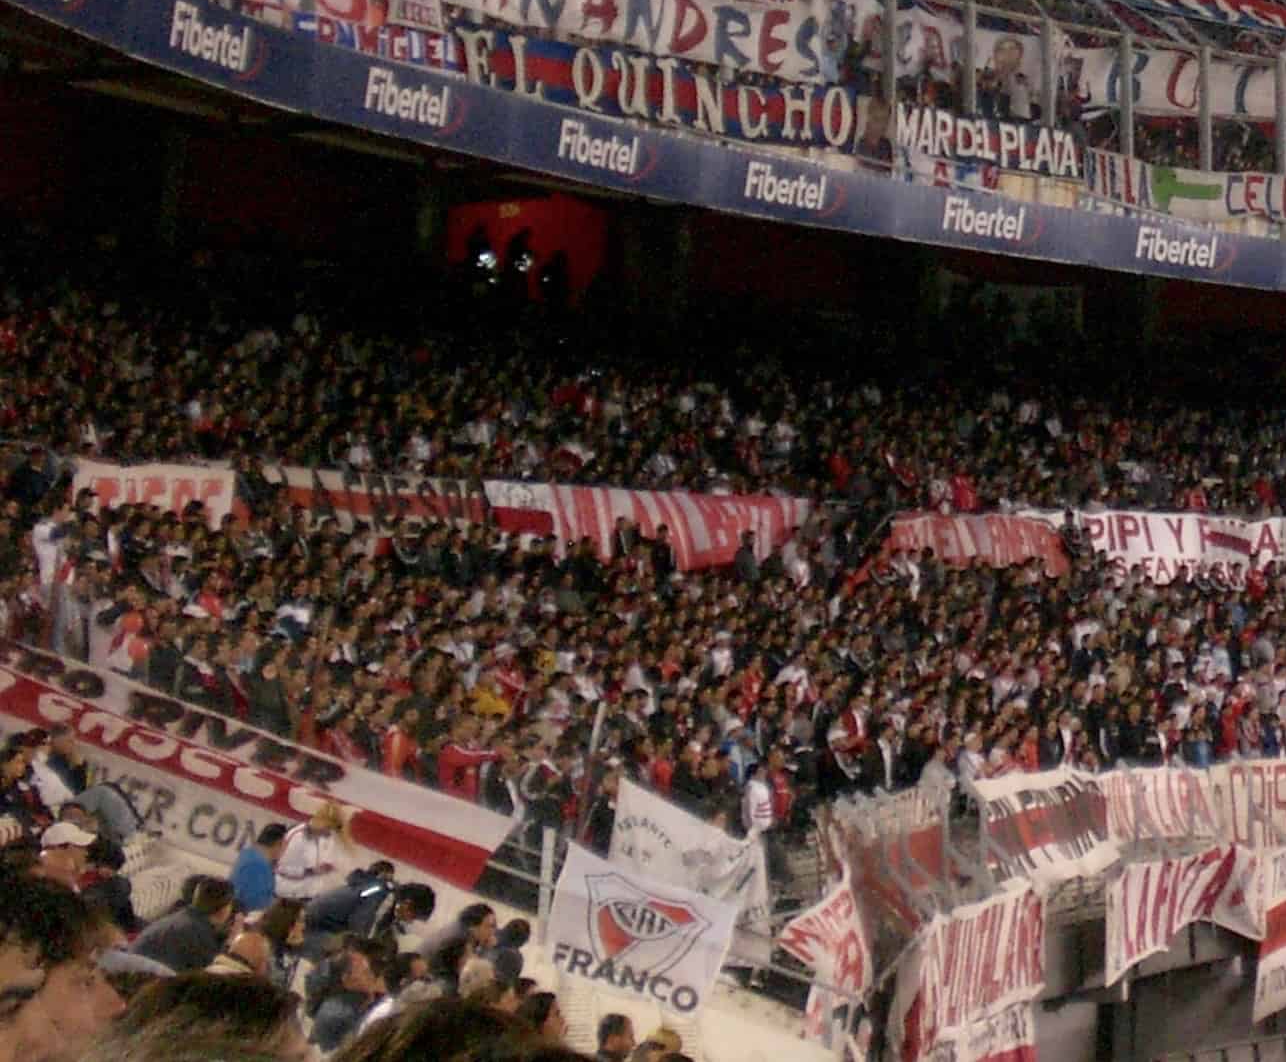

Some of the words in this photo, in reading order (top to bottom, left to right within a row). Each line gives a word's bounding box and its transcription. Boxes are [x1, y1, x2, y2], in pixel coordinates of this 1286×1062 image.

[170, 0, 250, 74] Fibertel
[364, 65, 449, 128] Fibertel
[464, 29, 546, 102] EL
[572, 45, 856, 148] QUINCHO
[557, 118, 639, 175] Fibertel
[898, 102, 952, 158] MAR
[1000, 121, 1079, 178] PLATA
[744, 161, 827, 210] Fibertel
[943, 196, 1025, 241] Fibertel
[1135, 226, 1217, 269] Fibertel
[127, 688, 346, 789] RIVER
[553, 943, 699, 1013] FRANCO
